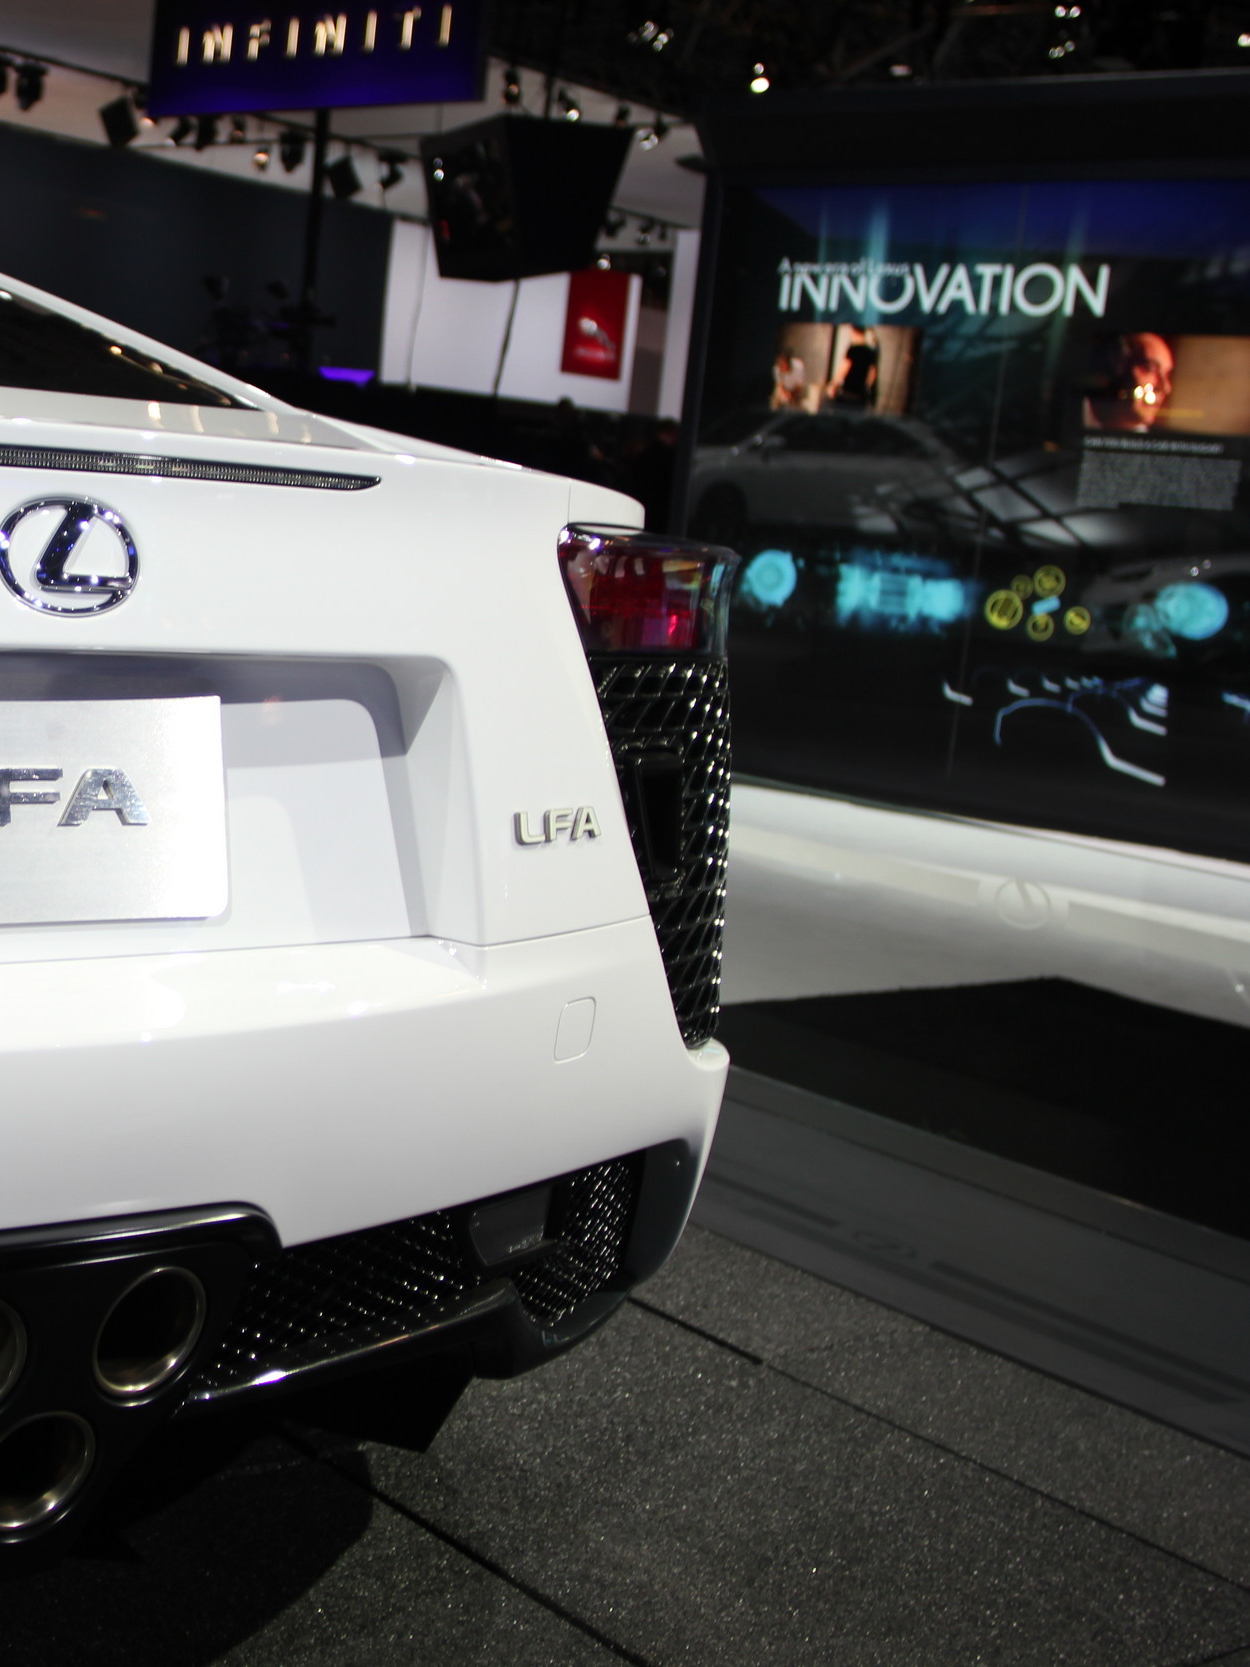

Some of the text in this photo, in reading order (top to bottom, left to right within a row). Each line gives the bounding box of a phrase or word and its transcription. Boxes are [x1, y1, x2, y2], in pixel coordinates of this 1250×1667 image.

[176, 4, 453, 66] INFINITI
[778, 262, 1111, 317] INNOVATION
[513, 806, 602, 846] LFA
